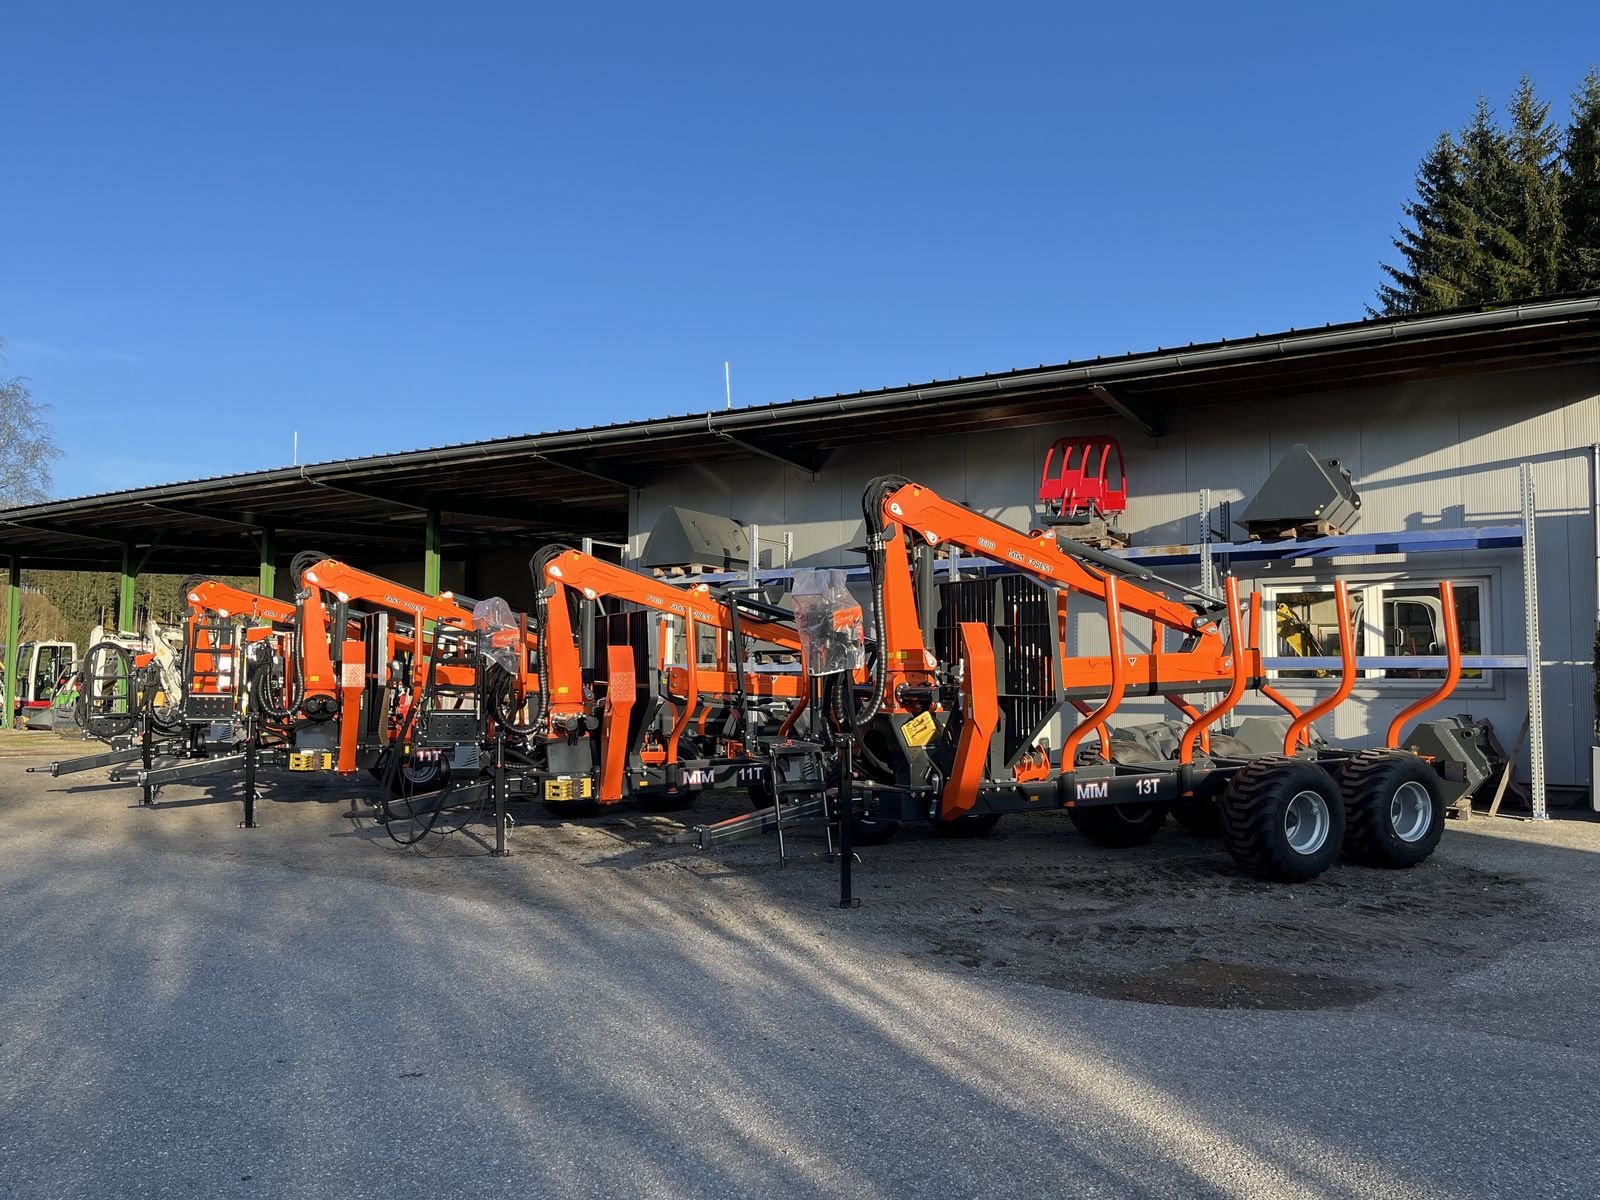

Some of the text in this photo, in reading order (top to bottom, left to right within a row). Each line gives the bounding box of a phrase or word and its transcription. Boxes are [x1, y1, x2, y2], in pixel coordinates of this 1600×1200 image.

[1008, 549, 1054, 573] MTM FOREST
[693, 610, 713, 621] OREST
[416, 750, 441, 761] 11T
[682, 767, 763, 785] MTM 11T
[1076, 778, 1160, 799] MTM 13T
